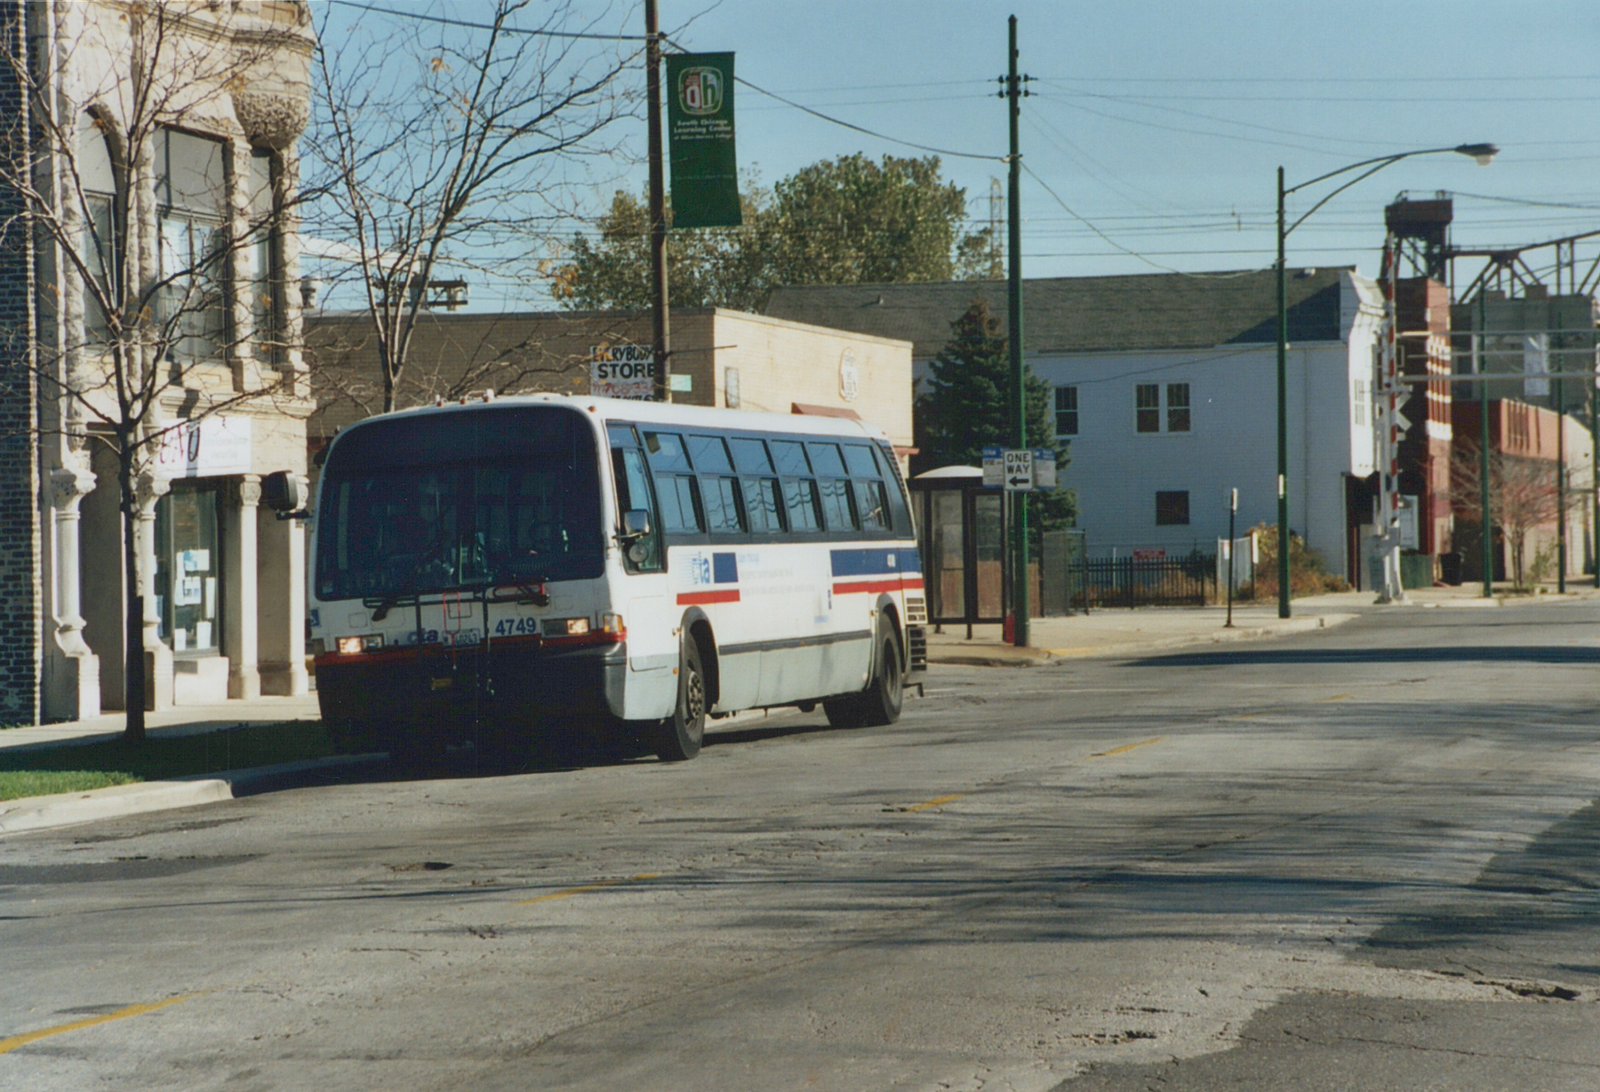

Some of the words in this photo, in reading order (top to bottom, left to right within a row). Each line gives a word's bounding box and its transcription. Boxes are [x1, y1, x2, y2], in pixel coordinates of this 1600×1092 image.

[598, 363, 655, 379] STORE
[1006, 453, 1030, 463] ONE
[1006, 464, 1030, 475] WAY
[495, 617, 536, 635] 4749
